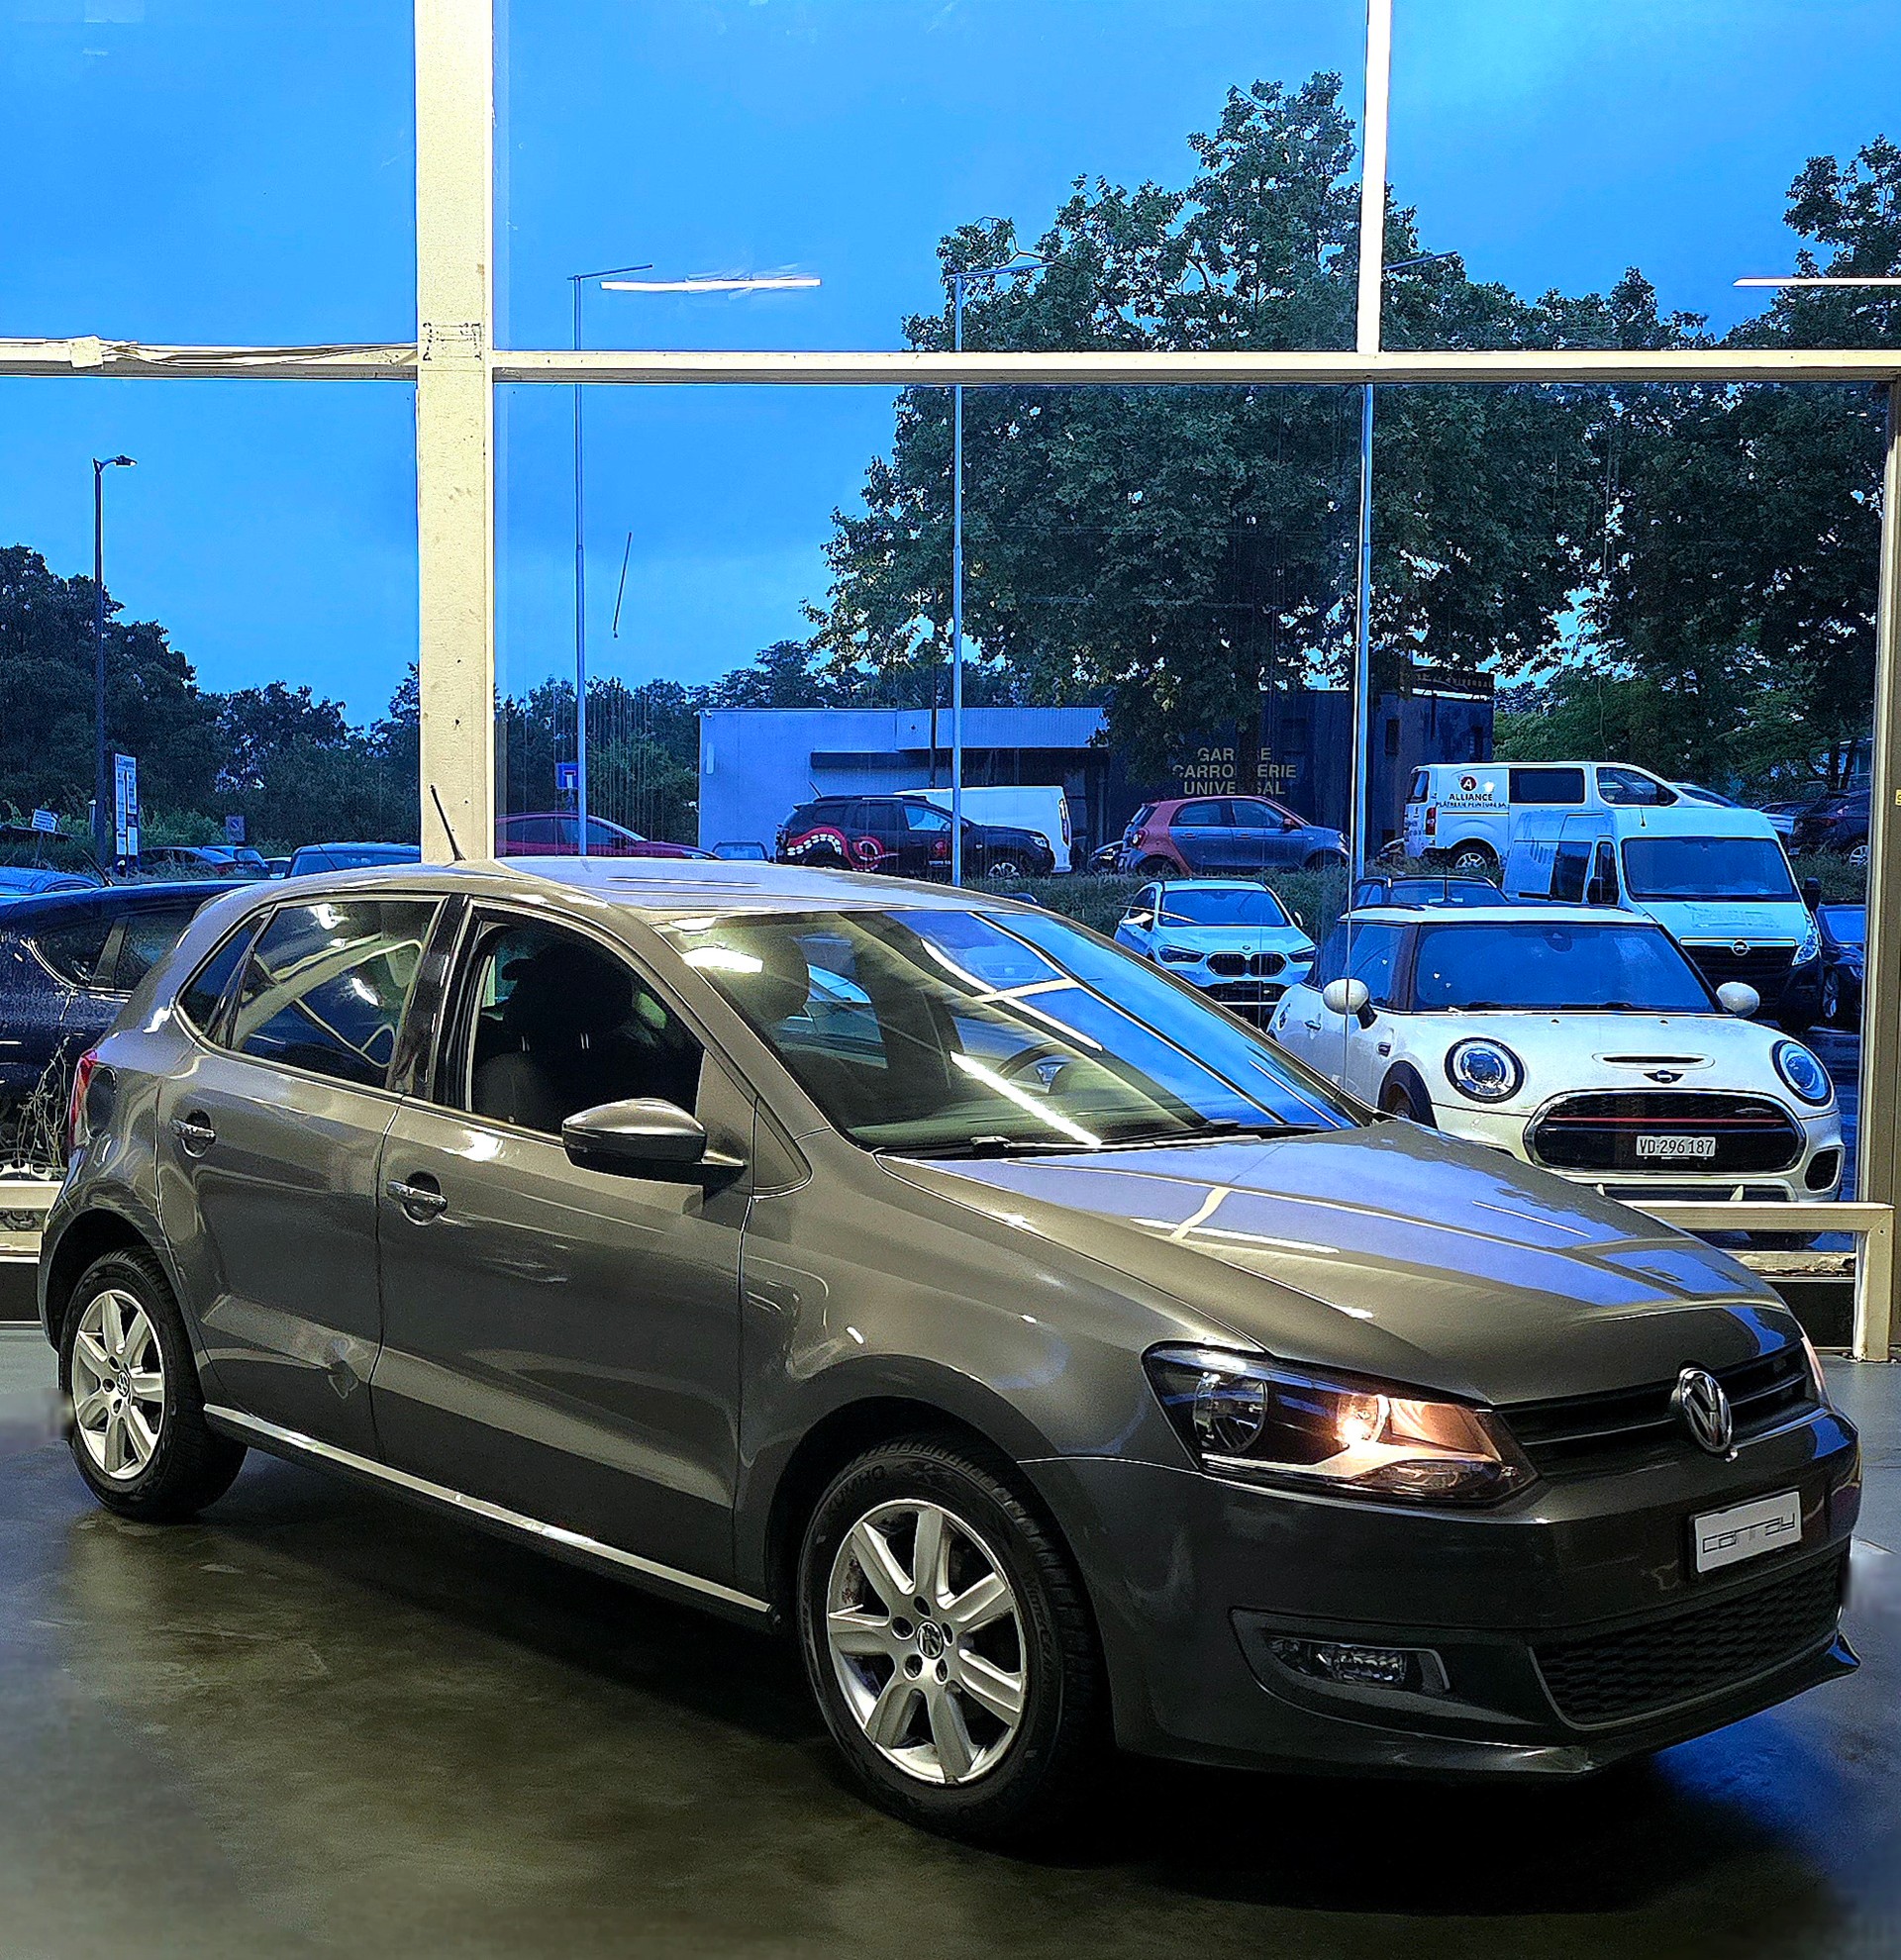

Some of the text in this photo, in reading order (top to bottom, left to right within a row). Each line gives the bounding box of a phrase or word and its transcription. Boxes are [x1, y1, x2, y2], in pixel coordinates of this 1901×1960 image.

[1197, 747, 1271, 761] GARE
[1172, 764, 1297, 778] CARROERIE
[1184, 781, 1286, 795] UNIVEAL
[1449, 793, 1493, 802] ALLIANCE
[1688, 1139, 1714, 1155] 187
